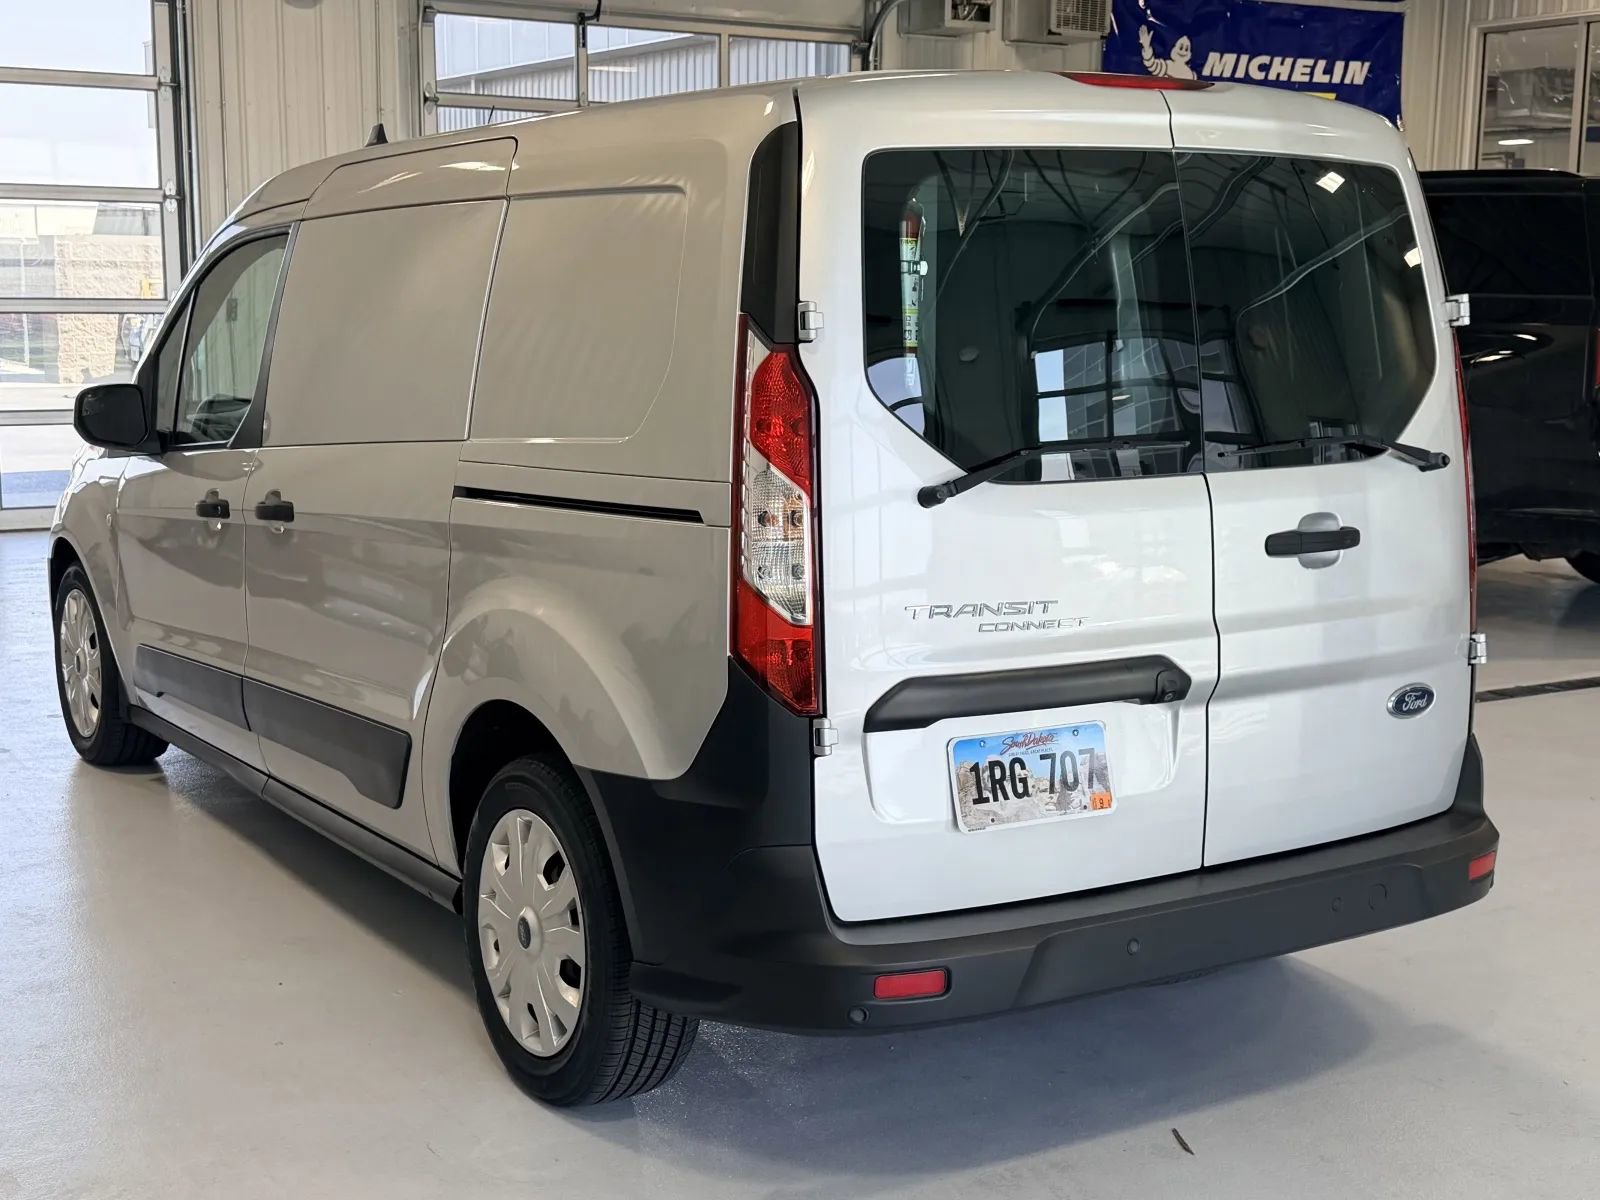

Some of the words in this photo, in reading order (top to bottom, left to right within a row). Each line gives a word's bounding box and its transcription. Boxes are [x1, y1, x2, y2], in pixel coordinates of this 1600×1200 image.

[1201, 51, 1371, 85] MICHELIN
[904, 599, 1059, 620] TRANSIT
[978, 615, 1091, 633] CONNECT
[1402, 691, 1428, 711] Ford
[969, 756, 1032, 805] 1RG
[1039, 747, 1096, 795] 707
